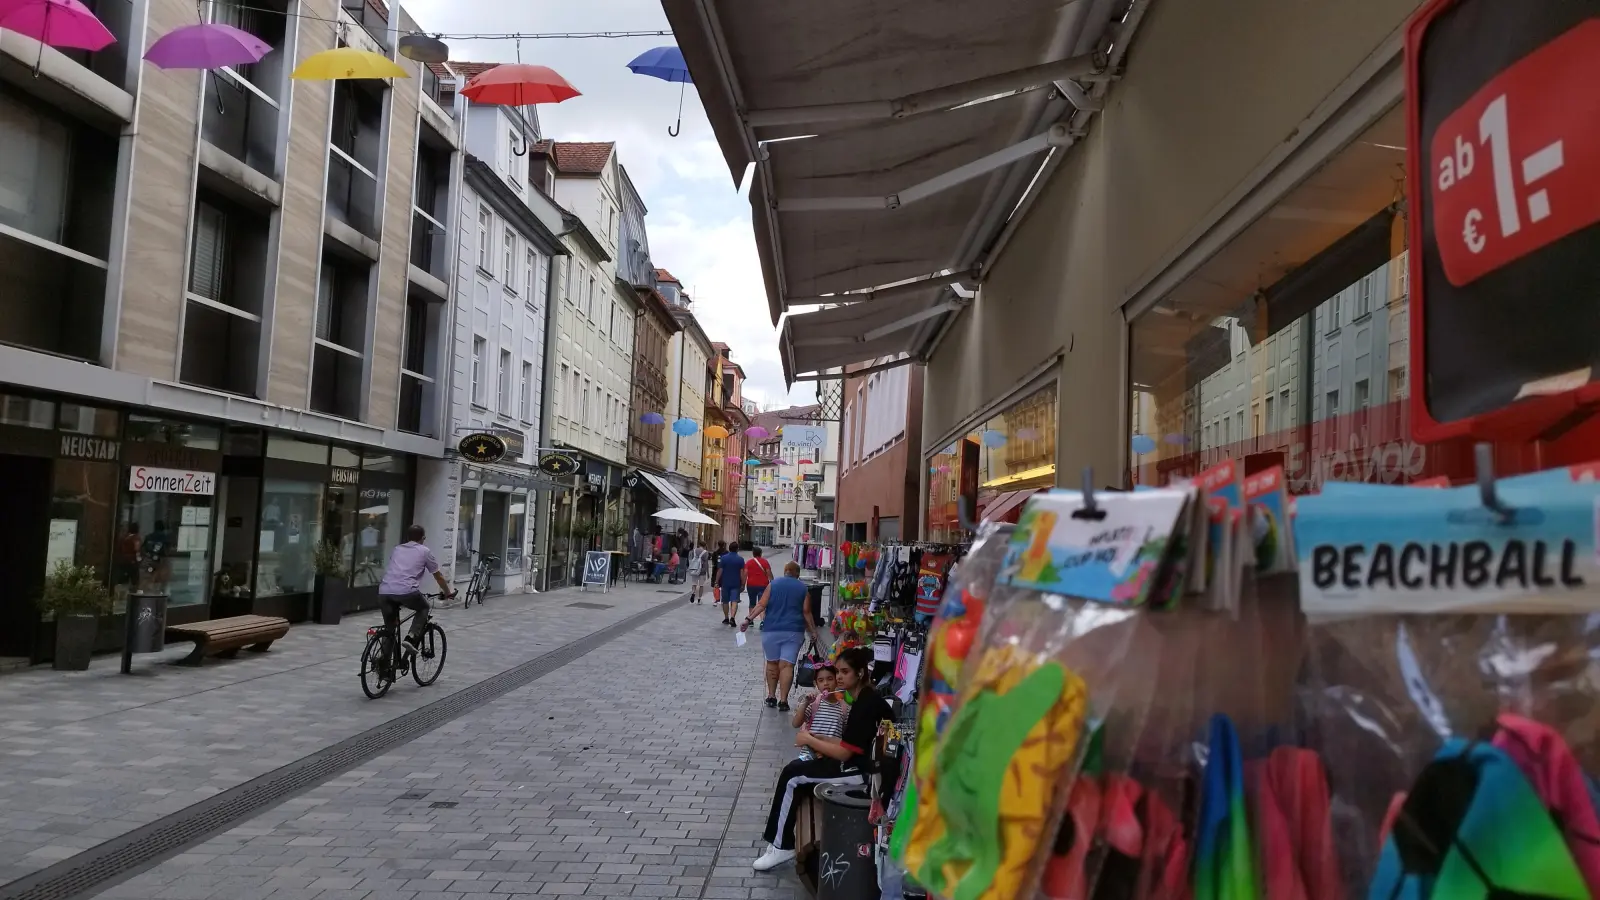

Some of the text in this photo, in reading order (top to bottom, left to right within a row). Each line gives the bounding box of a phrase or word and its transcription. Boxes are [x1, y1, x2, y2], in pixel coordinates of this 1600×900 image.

[1437, 133, 1474, 192] ab
[1461, 207, 1486, 254] €
[61, 435, 121, 461] NEUSTADT
[134, 468, 211, 494] SonnenZeit
[331, 468, 360, 484] NEUSTADT
[1311, 537, 1587, 591] BEACHBALL
